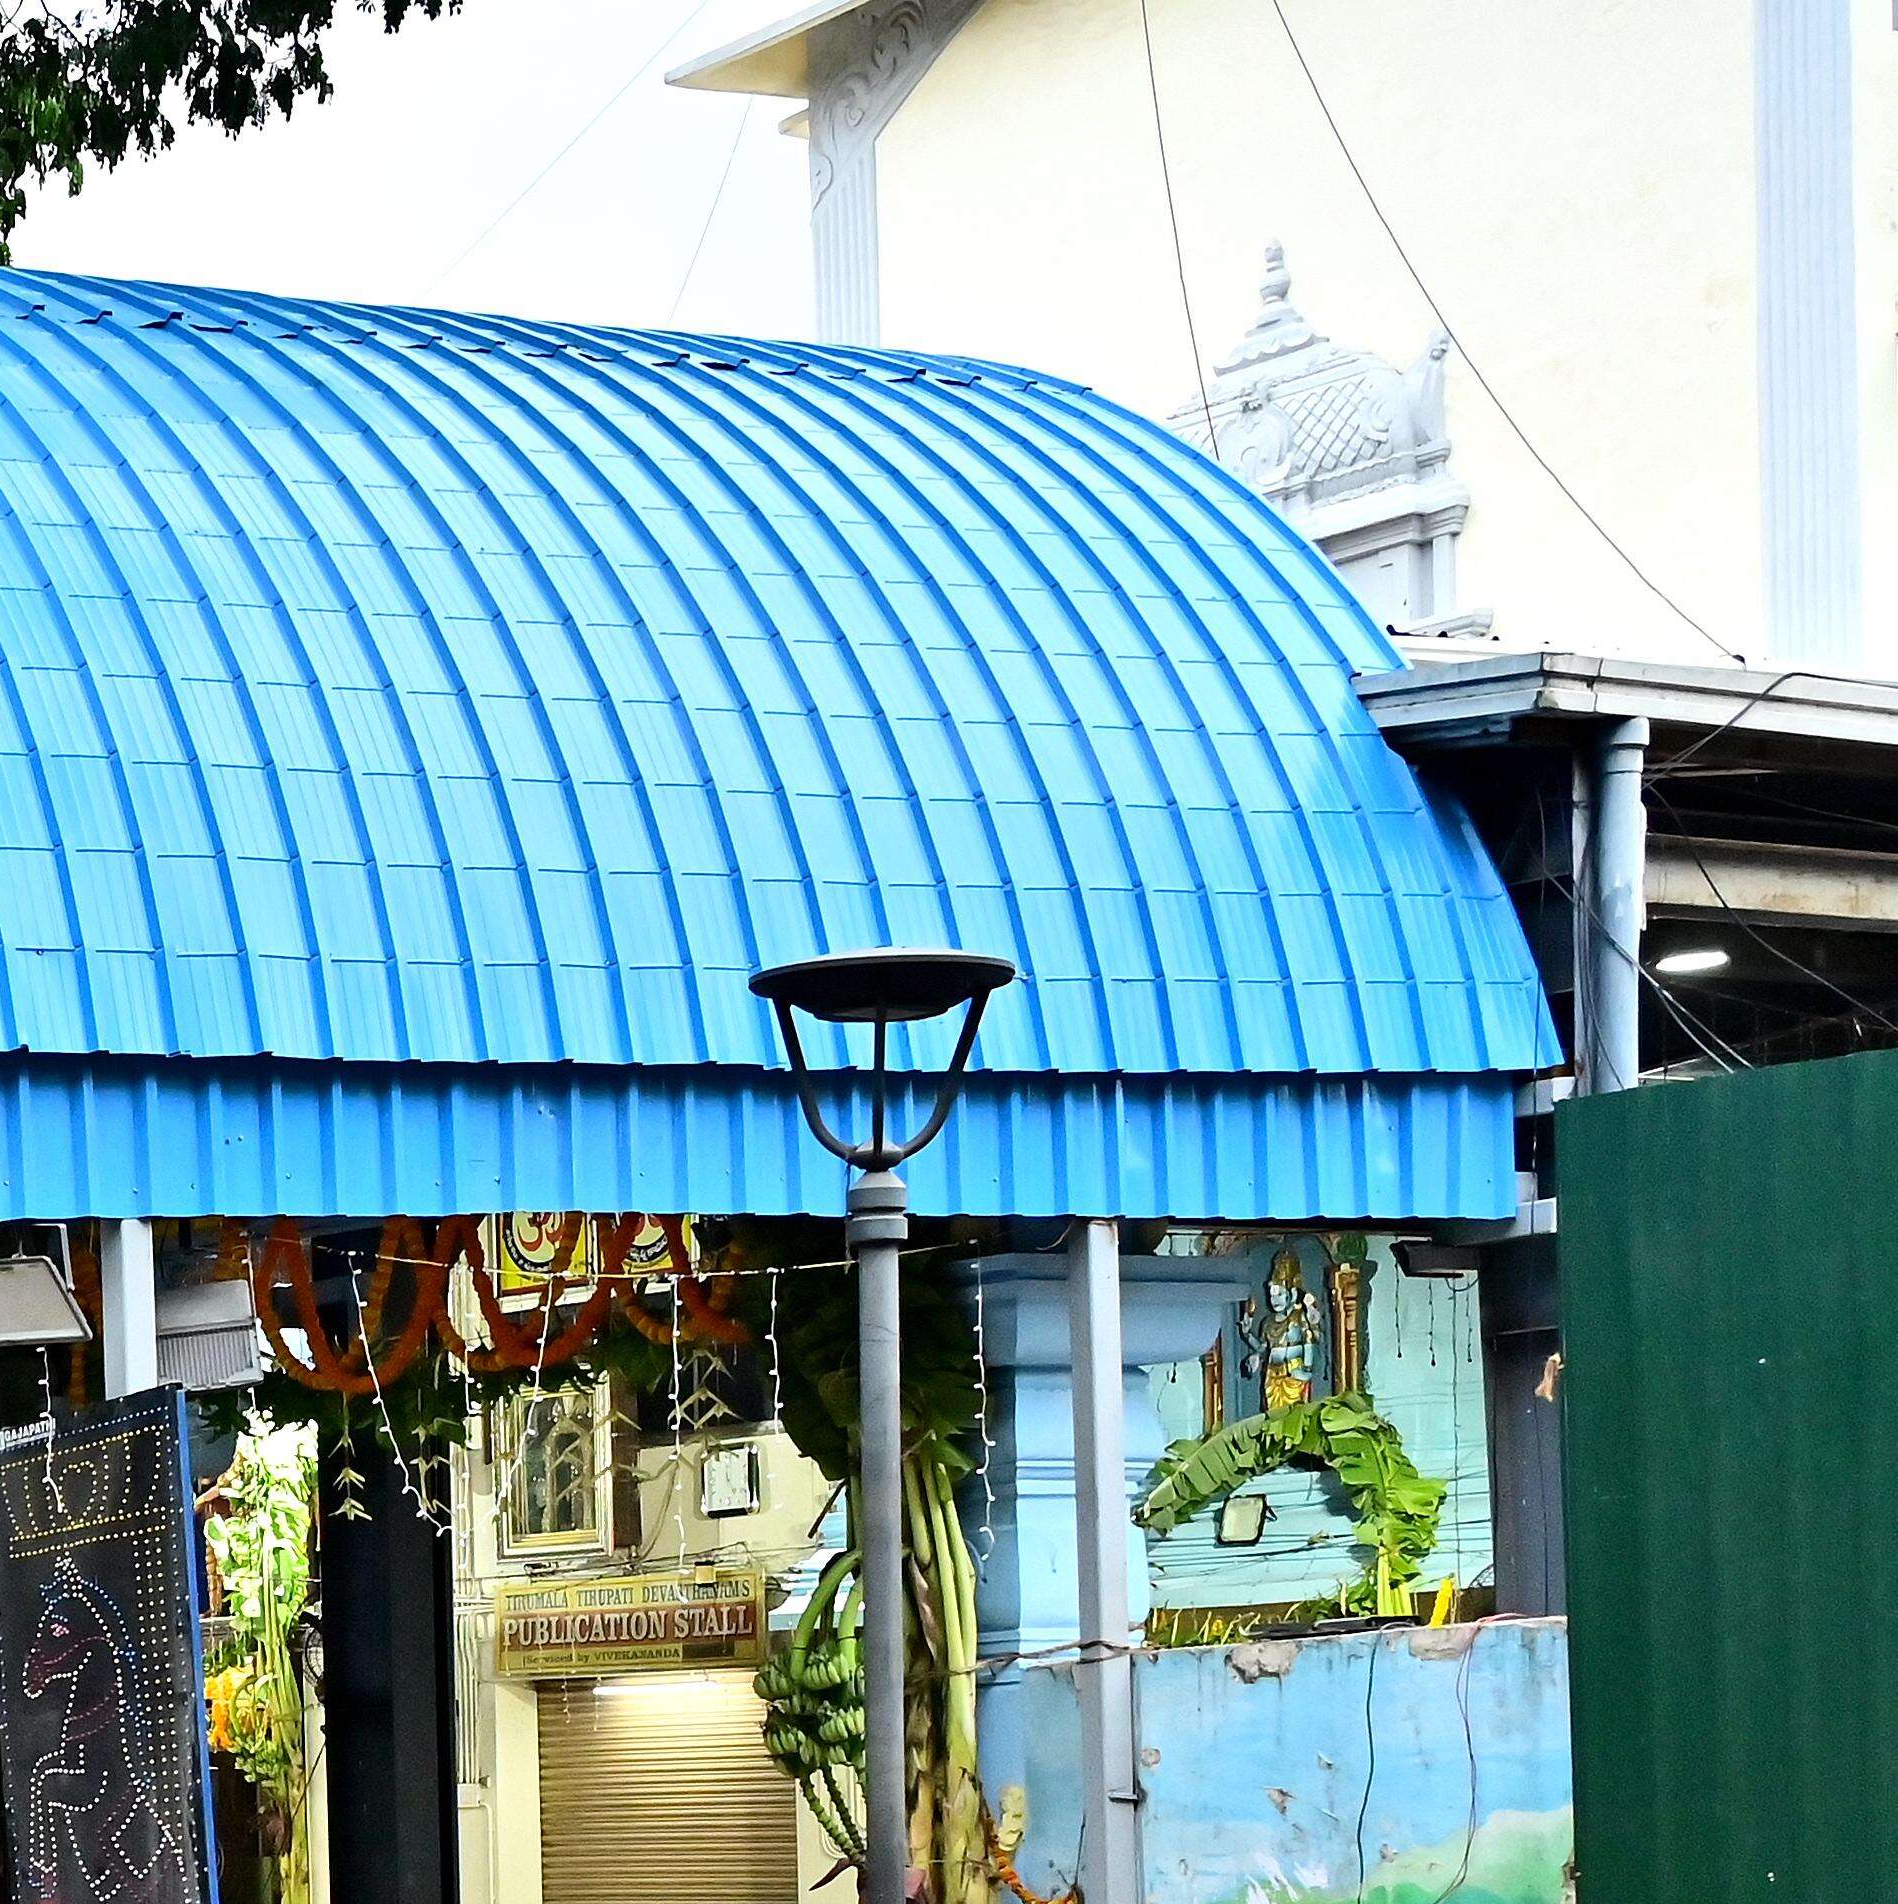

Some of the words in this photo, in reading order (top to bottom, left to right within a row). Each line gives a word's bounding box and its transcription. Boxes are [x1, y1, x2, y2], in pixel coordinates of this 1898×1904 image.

[506, 1591, 568, 1612] TIRUMALA
[576, 1587, 634, 1608] TIRUPATI
[503, 1610, 667, 1647] PUBLICATION
[674, 1605, 753, 1638] STALL
[594, 1648, 680, 1662] VIVEKANANDA
